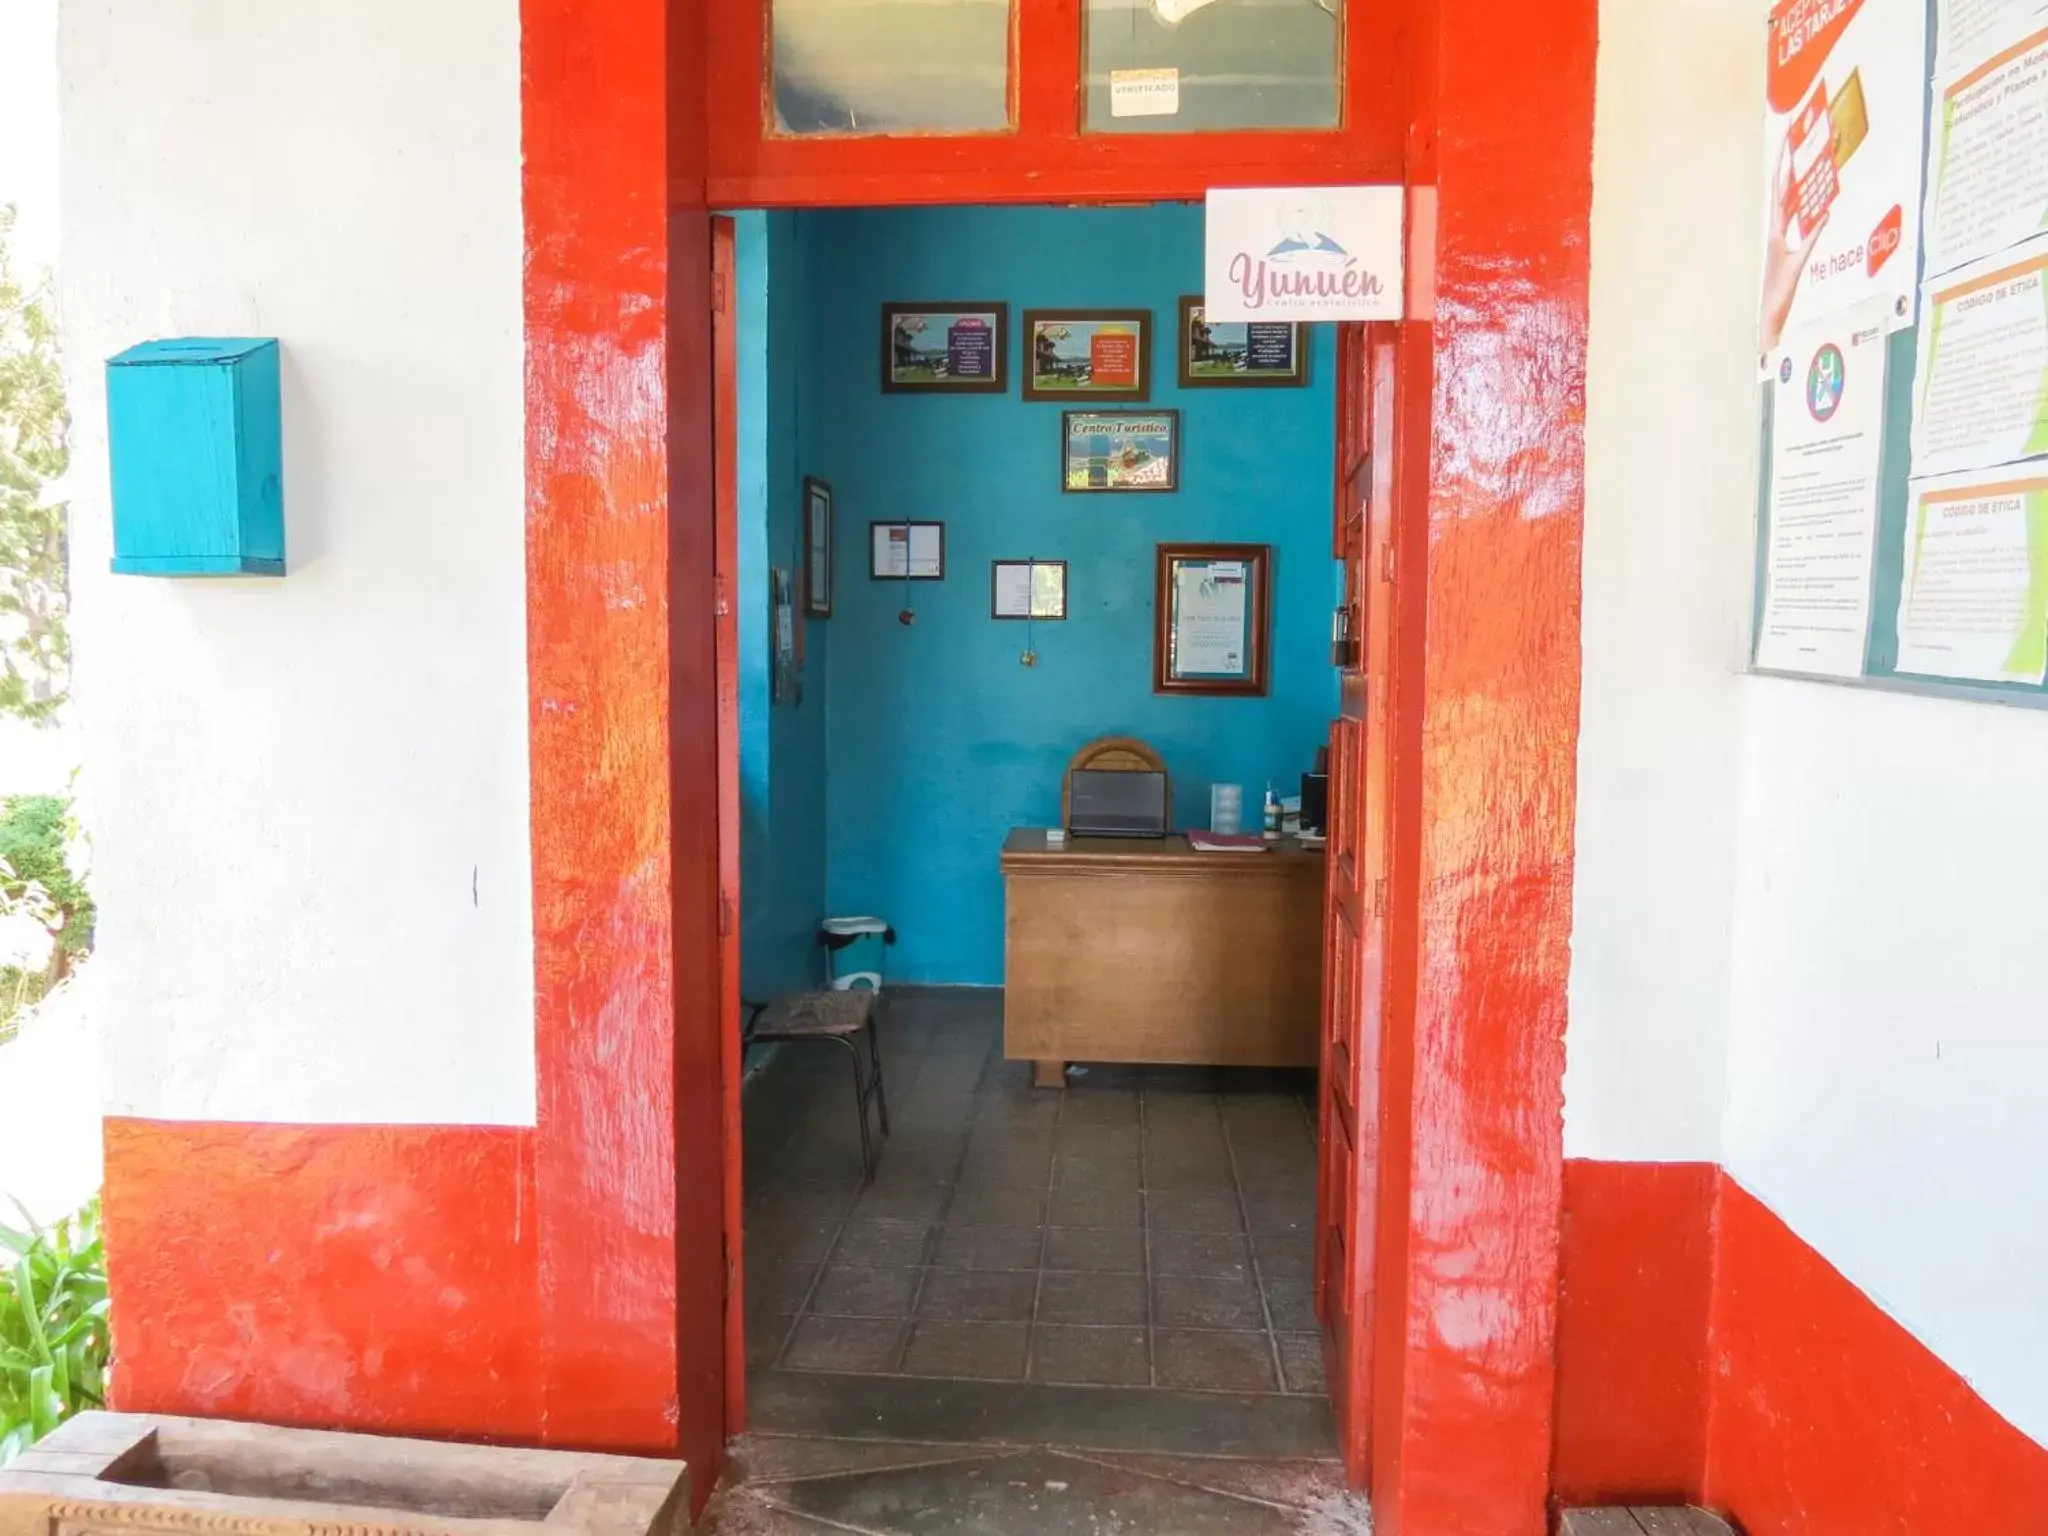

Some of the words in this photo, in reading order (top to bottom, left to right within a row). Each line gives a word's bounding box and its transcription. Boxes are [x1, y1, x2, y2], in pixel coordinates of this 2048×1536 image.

[1778, 28, 1804, 67] LAS
[1810, 261, 1826, 286] Me
[1830, 244, 1864, 275] hace
[1229, 252, 1383, 309] Yunuén
[1995, 286, 2009, 301] DE
[1073, 422, 1115, 434] Centro
[1977, 502, 1990, 514] DE
